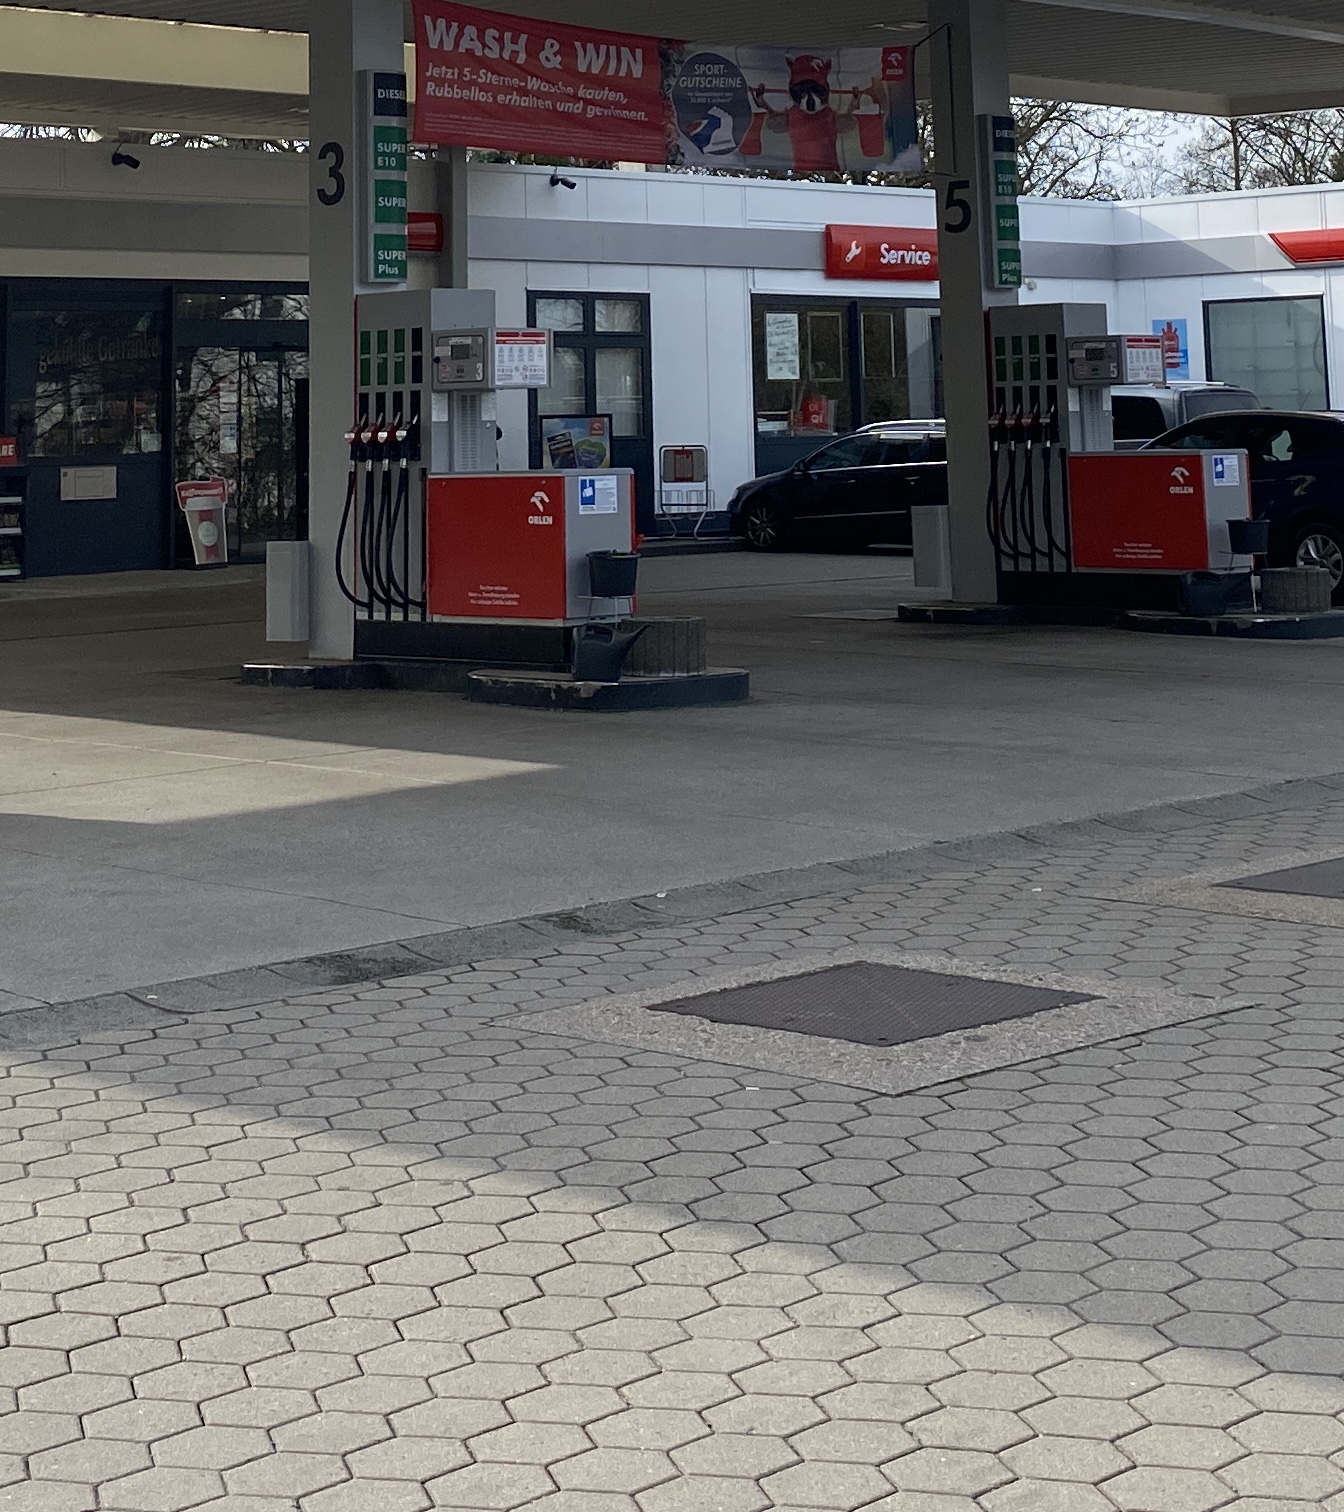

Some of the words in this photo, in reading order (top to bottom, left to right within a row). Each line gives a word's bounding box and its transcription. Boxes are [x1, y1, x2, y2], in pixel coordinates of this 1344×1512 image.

[423, 14, 528, 64] WASH
[539, 38, 563, 70] &
[574, 40, 644, 78] WIN
[694, 63, 729, 76] SPORT-
[425, 62, 460, 80] Jetzt
[578, 83, 628, 105] kaufen,
[679, 76, 743, 89] GUTSCHEINE
[425, 81, 493, 104] Rubbellos
[497, 91, 553, 111] erhalten
[557, 100, 584, 114] und
[587, 104, 650, 122] gewinnen.
[377, 142, 406, 154] SUPER
[377, 156, 397, 167] E10
[317, 141, 346, 206] 3
[378, 197, 406, 208] SUPER
[944, 179, 972, 234] 5
[377, 250, 406, 261] SUPER
[879, 242, 931, 265] Service
[378, 264, 399, 275] Plus
[476, 363, 483, 381] 3
[1109, 362, 1118, 377] 5
[527, 515, 553, 525] ORLEN
